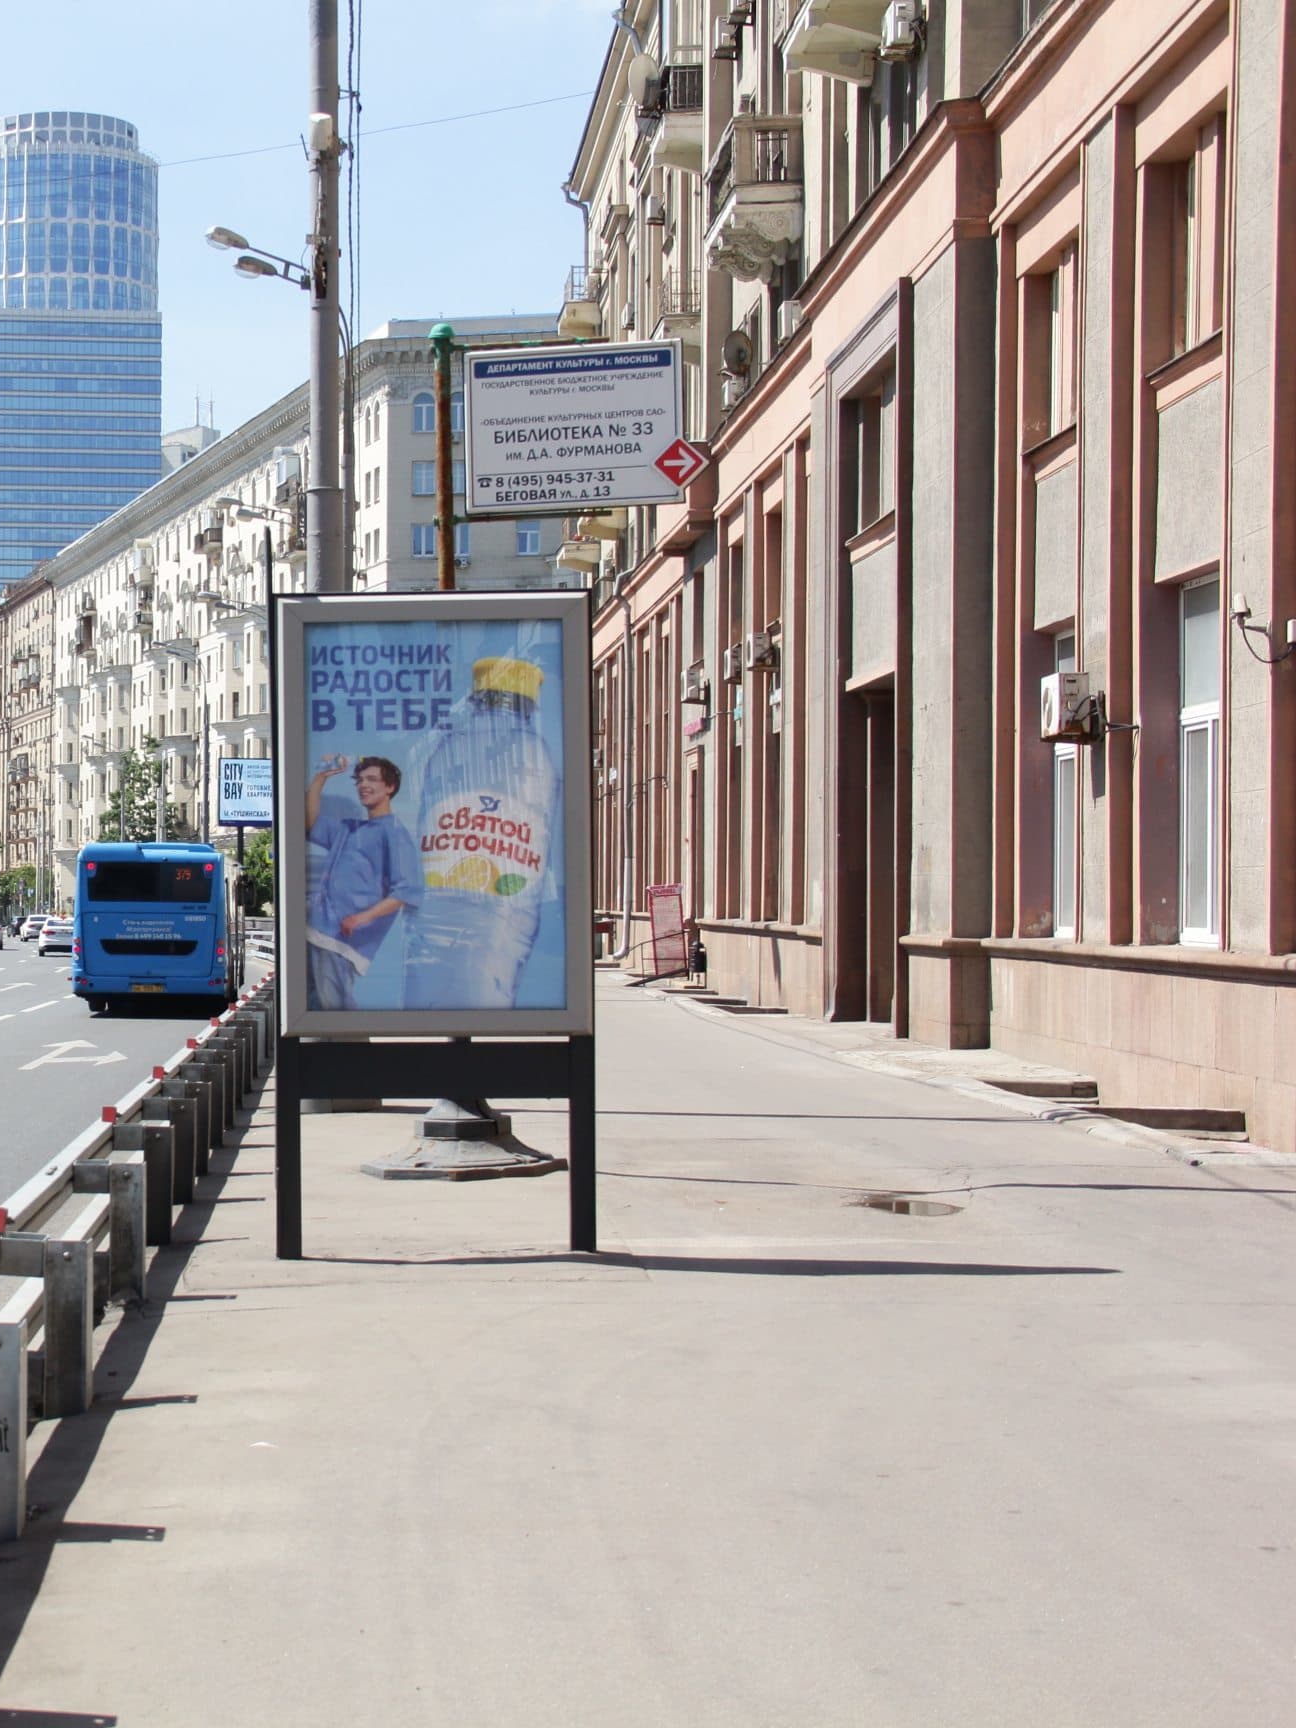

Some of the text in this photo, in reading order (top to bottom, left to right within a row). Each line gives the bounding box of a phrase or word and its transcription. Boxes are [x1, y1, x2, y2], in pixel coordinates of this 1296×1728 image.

[487, 361, 553, 374] ДЕПАРТАМЕНТ
[555, 358, 603, 369] КУЛЬТУРЫ
[614, 354, 658, 365] МОСКВЫ
[481, 371, 664, 389] ГОСУДАРСТВЕННОЕ БЮДЖЕТНОЕ УЧРЕЖДЕНИЕ
[530, 388, 570, 396] КУЛЬТУРЫ
[579, 384, 615, 393] МОСКВЫ
[548, 411, 603, 421] КУЛЬТУРНЫХ
[605, 409, 644, 419] ЦЕНТРОВ
[494, 421, 653, 444] БИБЛИОТЕКА № 33
[527, 448, 552, 461] Д.А.
[557, 442, 642, 457] ФУРМАНОВА
[496, 471, 615, 489] 8 (495) 945-37-31
[496, 489, 557, 502] БЕГОВАЯ
[594, 486, 611, 497] 13
[311, 644, 452, 666] ИСТОЧНИК
[311, 669, 452, 697] РАДОСТИ
[312, 698, 453, 732] В ТЕБЕ
[224, 763, 243, 780] CITY
[224, 782, 243, 800] BAY
